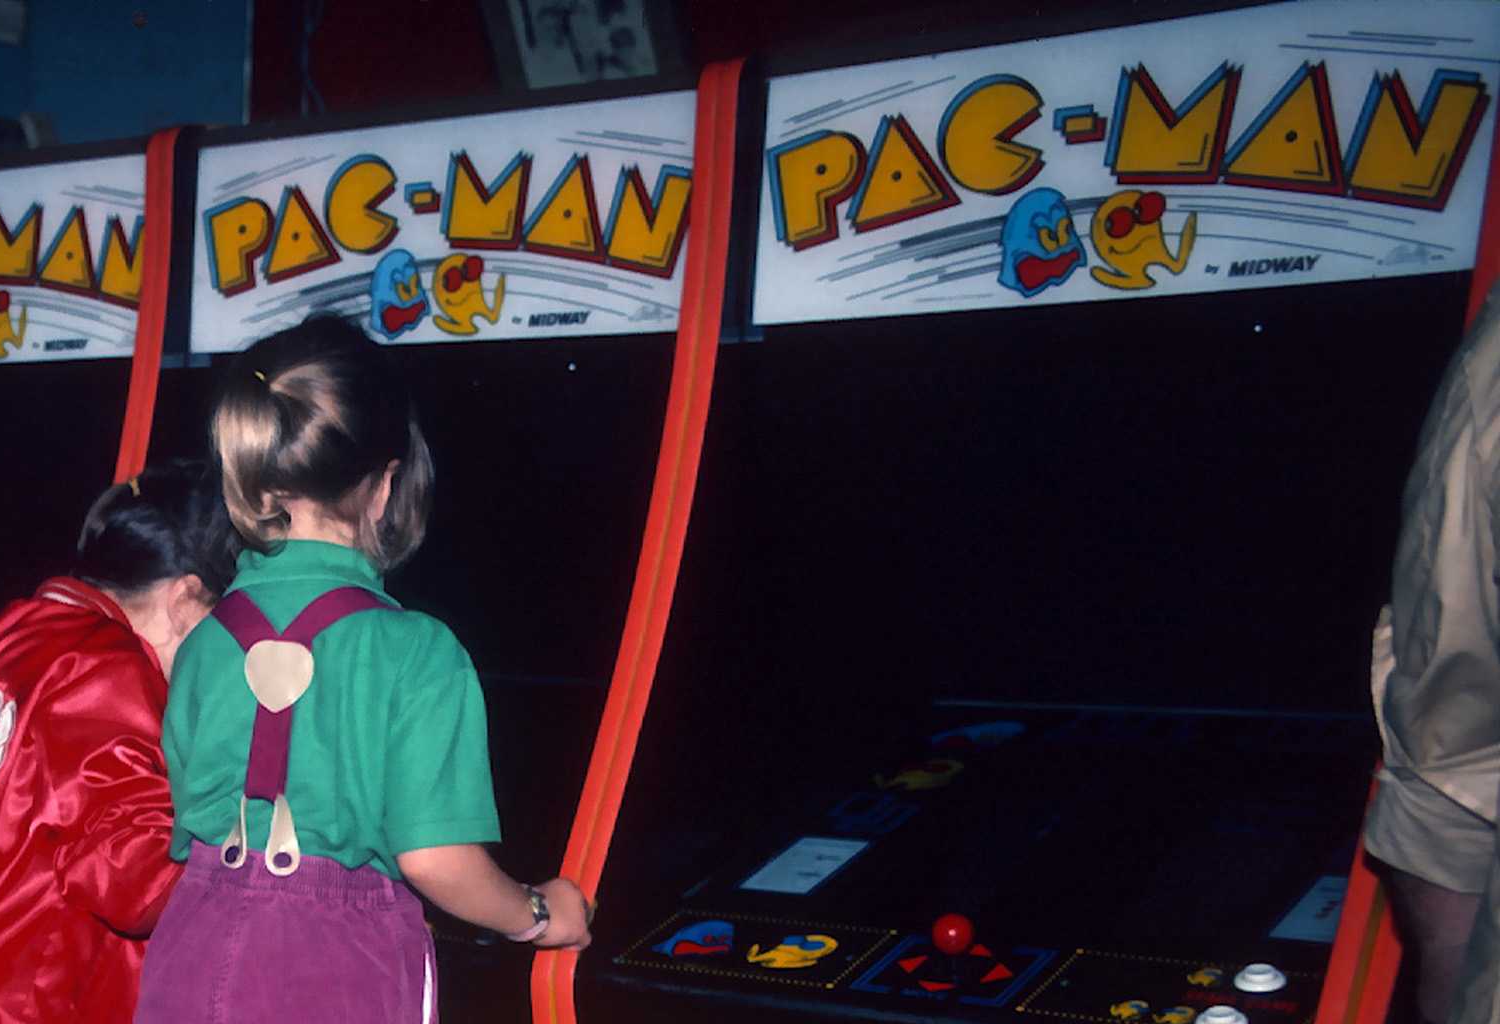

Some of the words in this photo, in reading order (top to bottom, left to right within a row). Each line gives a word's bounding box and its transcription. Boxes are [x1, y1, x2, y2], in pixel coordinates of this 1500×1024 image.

[766, 59, 1490, 252] PAC-MAN
[202, 149, 693, 298] PAC-MAN
[1228, 255, 1321, 277] MIDWAY
[528, 310, 591, 327] MIDWAY
